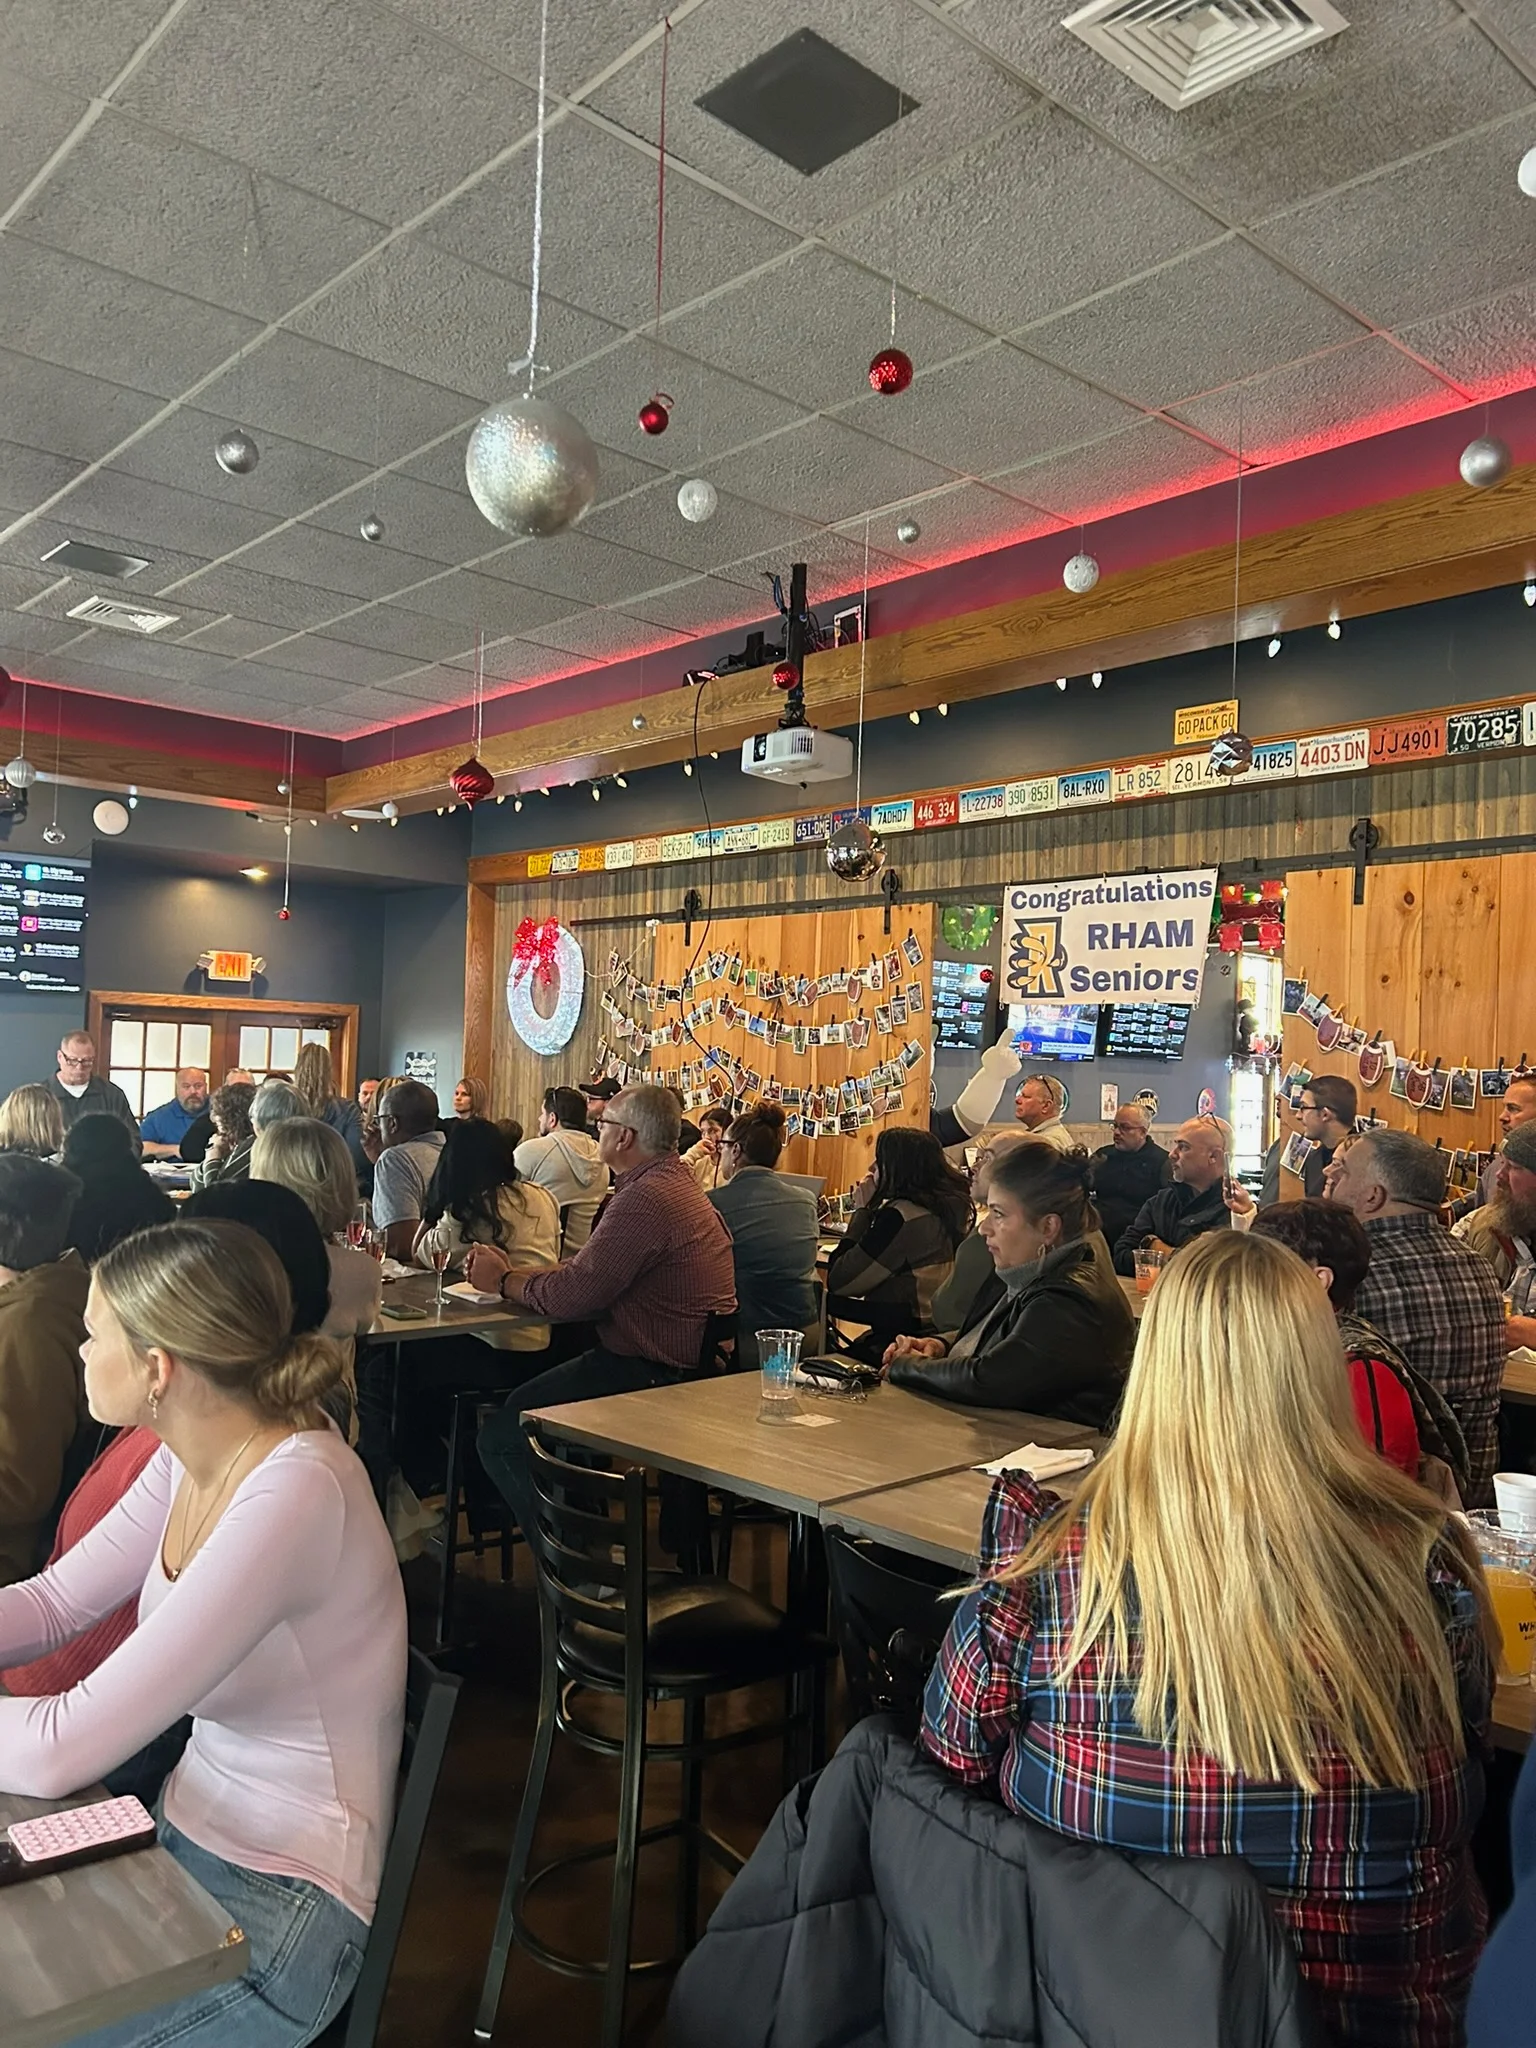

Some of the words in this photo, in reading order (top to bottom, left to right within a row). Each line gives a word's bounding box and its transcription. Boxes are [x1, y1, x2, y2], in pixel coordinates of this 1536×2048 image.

[1177, 720, 1192, 736] GO
[1193, 715, 1221, 733] PACK
[1221, 712, 1235, 729] GO
[1449, 714, 1518, 745] 70285
[1300, 744, 1341, 767] 4403
[1345, 740, 1365, 761] DN
[1373, 728, 1439, 755] JJ4901
[1118, 774, 1134, 792] LR
[1138, 769, 1161, 788] 852
[917, 804, 934, 821] 446
[938, 800, 956, 818] 334
[1008, 789, 1026, 806] 390
[1011, 878, 1213, 913] Congratulations
[1088, 918, 1194, 951] RHAM
[215, 952, 247, 978] EXIT
[1070, 963, 1200, 993] Seniors
